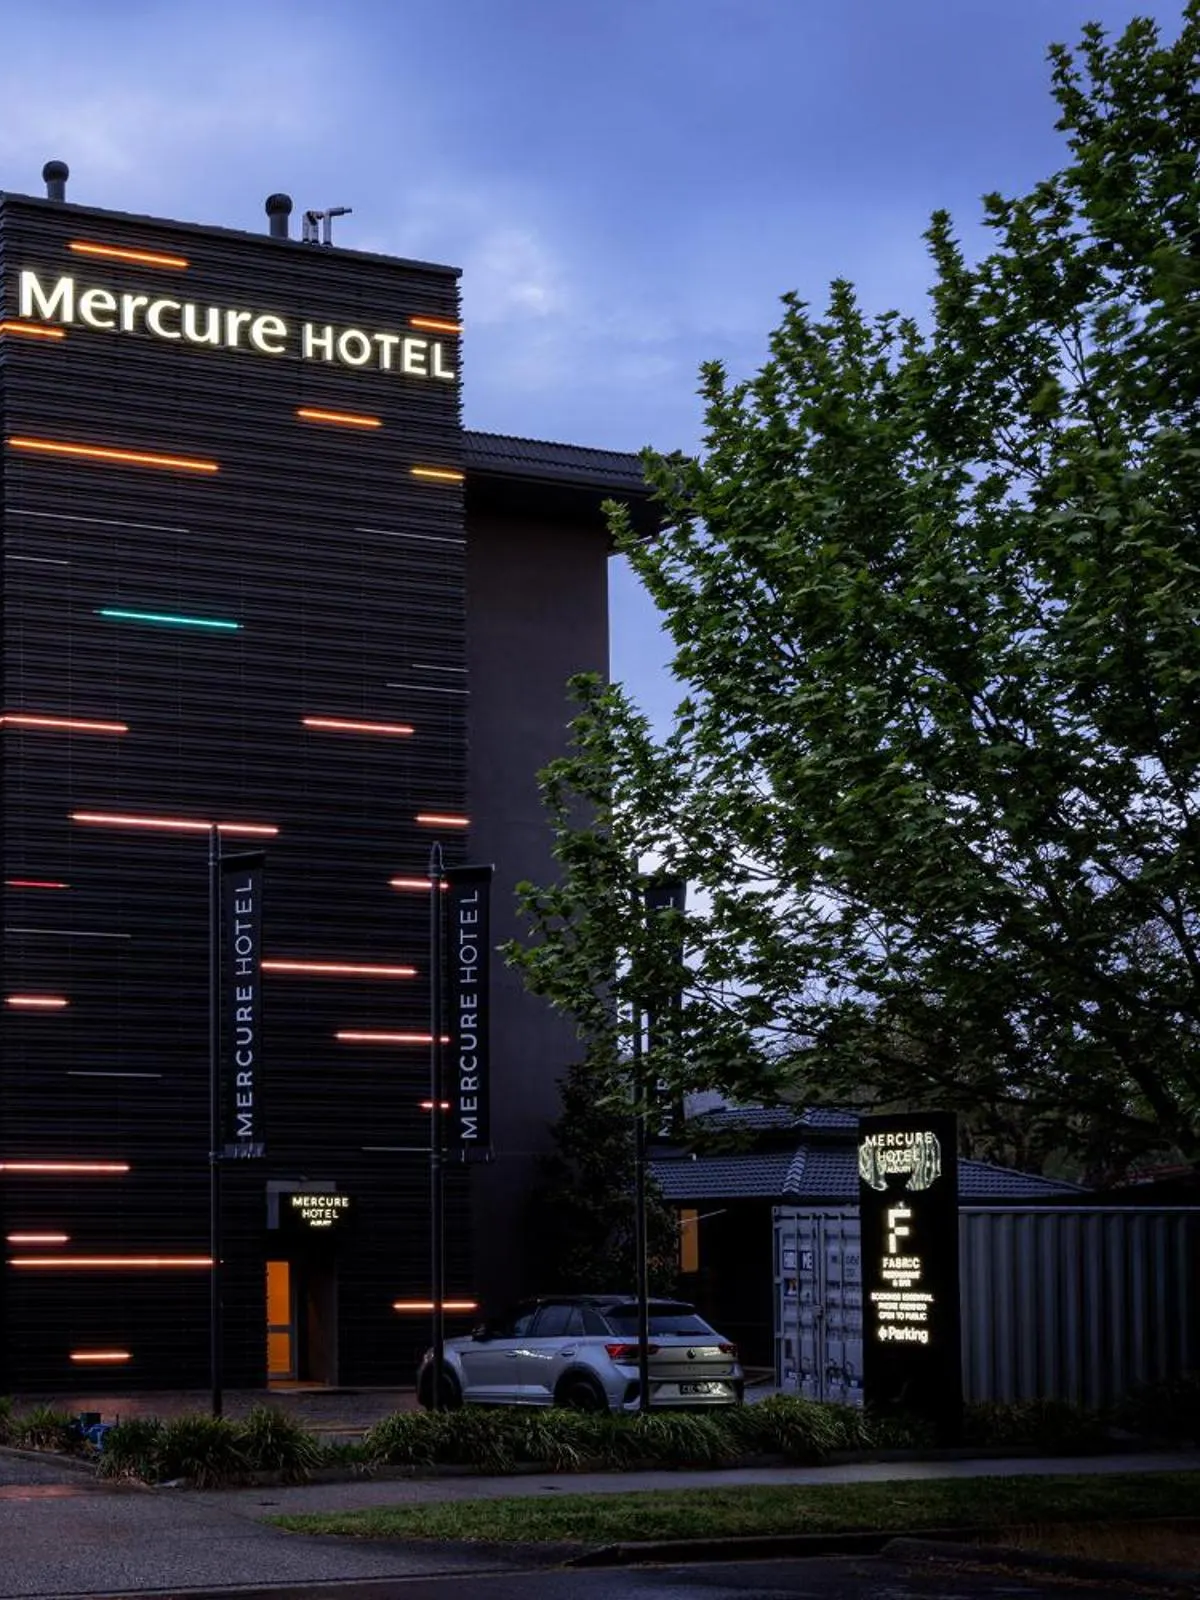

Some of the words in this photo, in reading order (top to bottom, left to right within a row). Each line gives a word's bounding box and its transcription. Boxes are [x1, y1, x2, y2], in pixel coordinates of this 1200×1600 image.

[19, 270, 288, 354] Mercure
[302, 322, 456, 380] HOTEL
[235, 879, 252, 976] HOTEL
[459, 890, 478, 983] HOTEL
[236, 985, 252, 1137] MERCURE
[460, 994, 478, 1139] MERCURE
[865, 1131, 933, 1147] MERCURE
[877, 1148, 921, 1162] HOTEL
[292, 1196, 349, 1207] MERCURE
[302, 1208, 339, 1219] HOTEL
[888, 1326, 928, 1343] Parking
